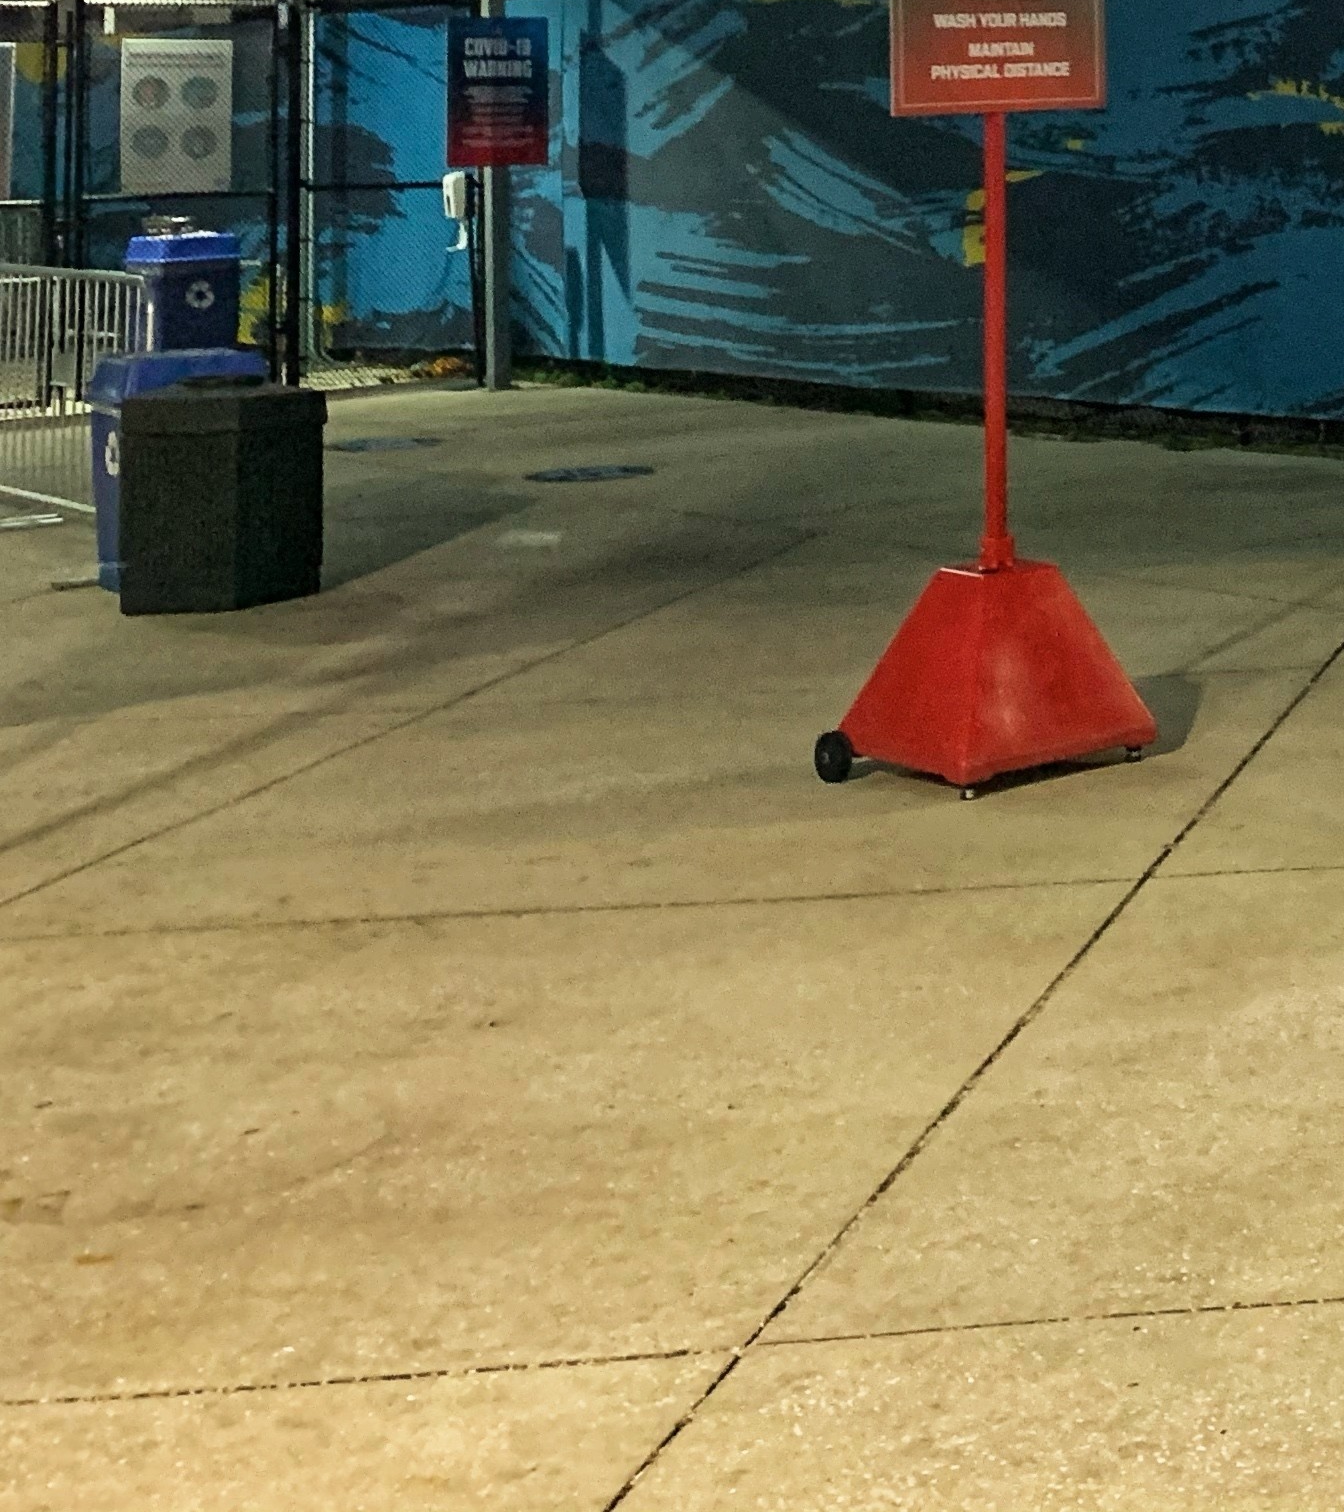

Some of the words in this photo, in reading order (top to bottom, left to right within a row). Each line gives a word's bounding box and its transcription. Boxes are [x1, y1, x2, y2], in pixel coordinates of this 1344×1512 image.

[933, 13, 977, 28] WASH
[979, 12, 1017, 28] YOUR
[1019, 11, 1067, 27] HANDS
[968, 41, 1035, 57] MAINTAIN
[930, 63, 1001, 80] PHYSICAL
[1003, 61, 1070, 78] DISTANCE
